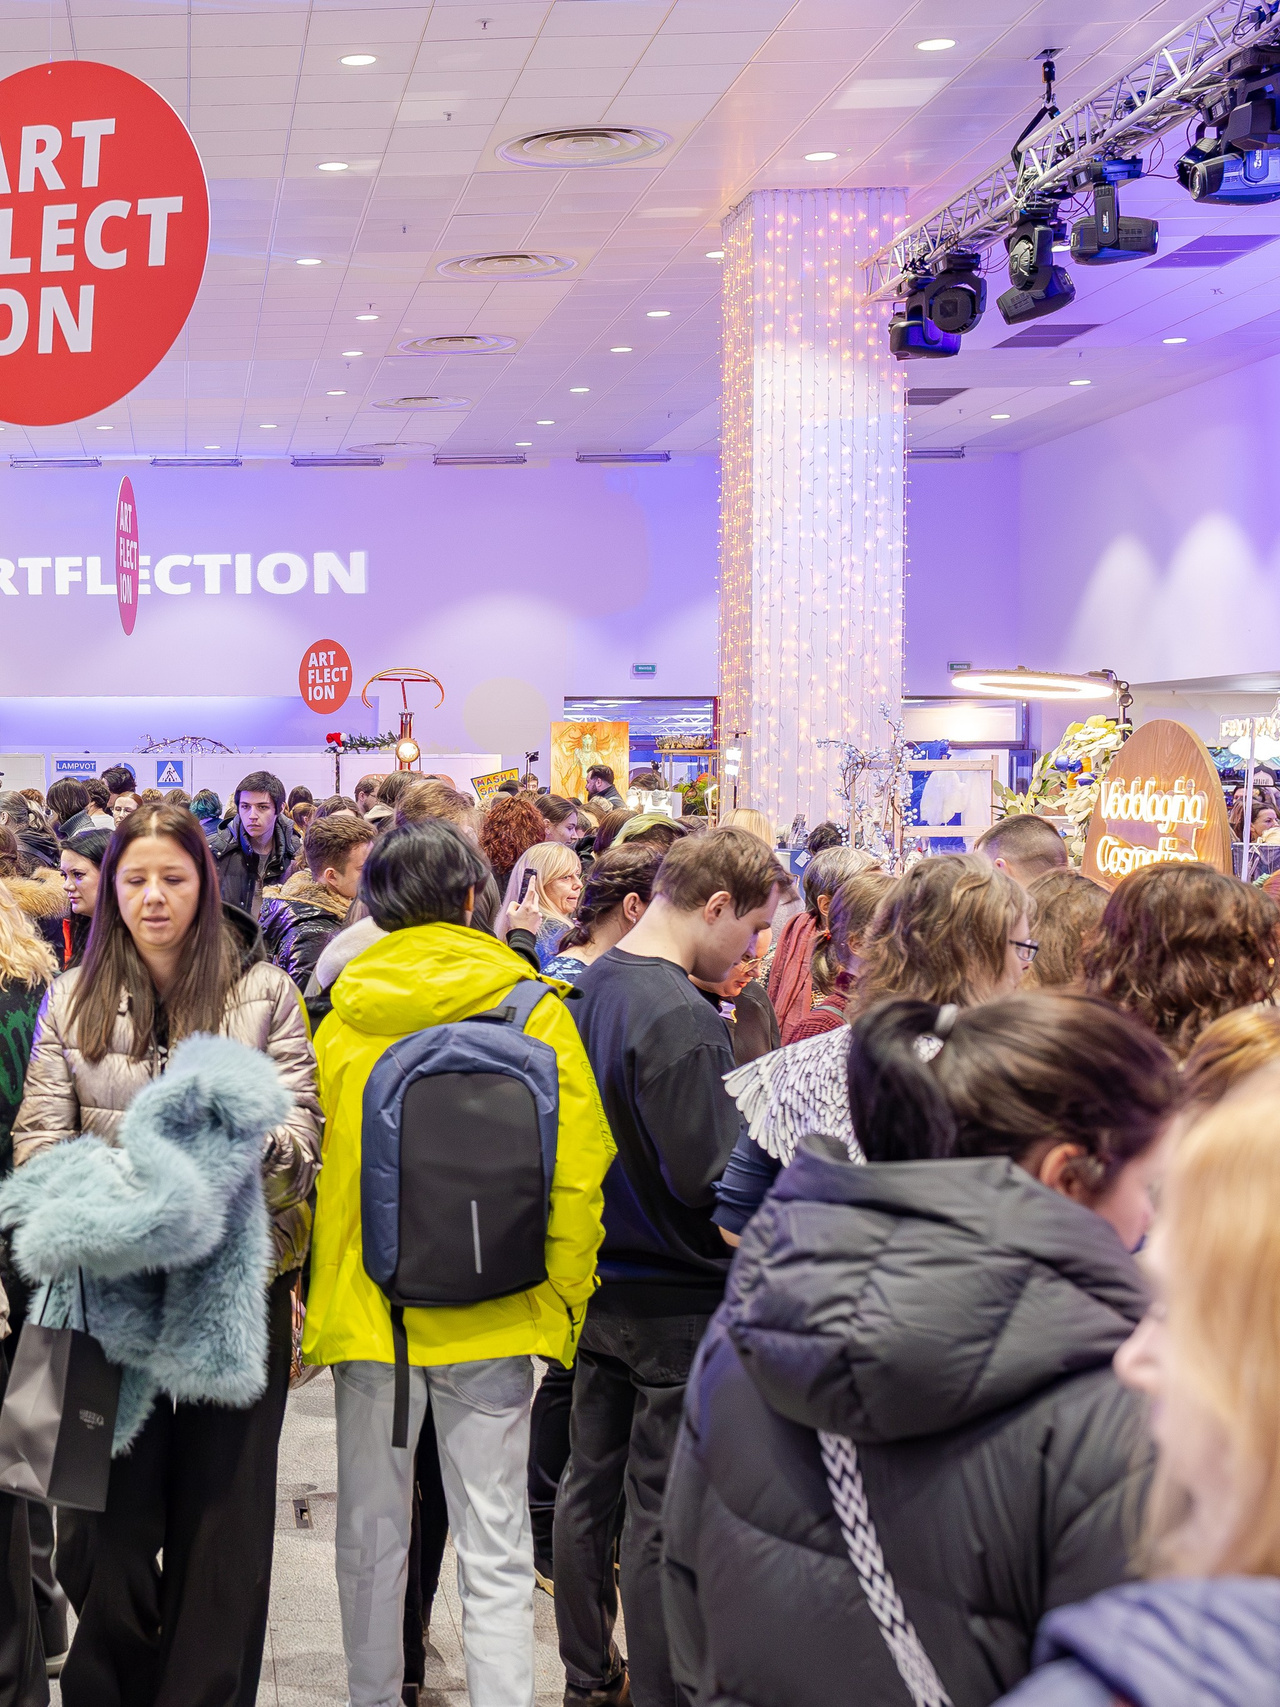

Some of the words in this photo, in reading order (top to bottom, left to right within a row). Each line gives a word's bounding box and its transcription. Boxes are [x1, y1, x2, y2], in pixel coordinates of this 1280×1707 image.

[119, 500, 133, 534] ART
[119, 536, 138, 571] FLECT
[119, 572, 133, 605] ION
[308, 650, 337, 668] ART
[308, 666, 349, 684] FLECT
[308, 684, 336, 701] ION
[57, 762, 96, 770] LAMPVOT
[477, 772, 515, 787] MASHA
